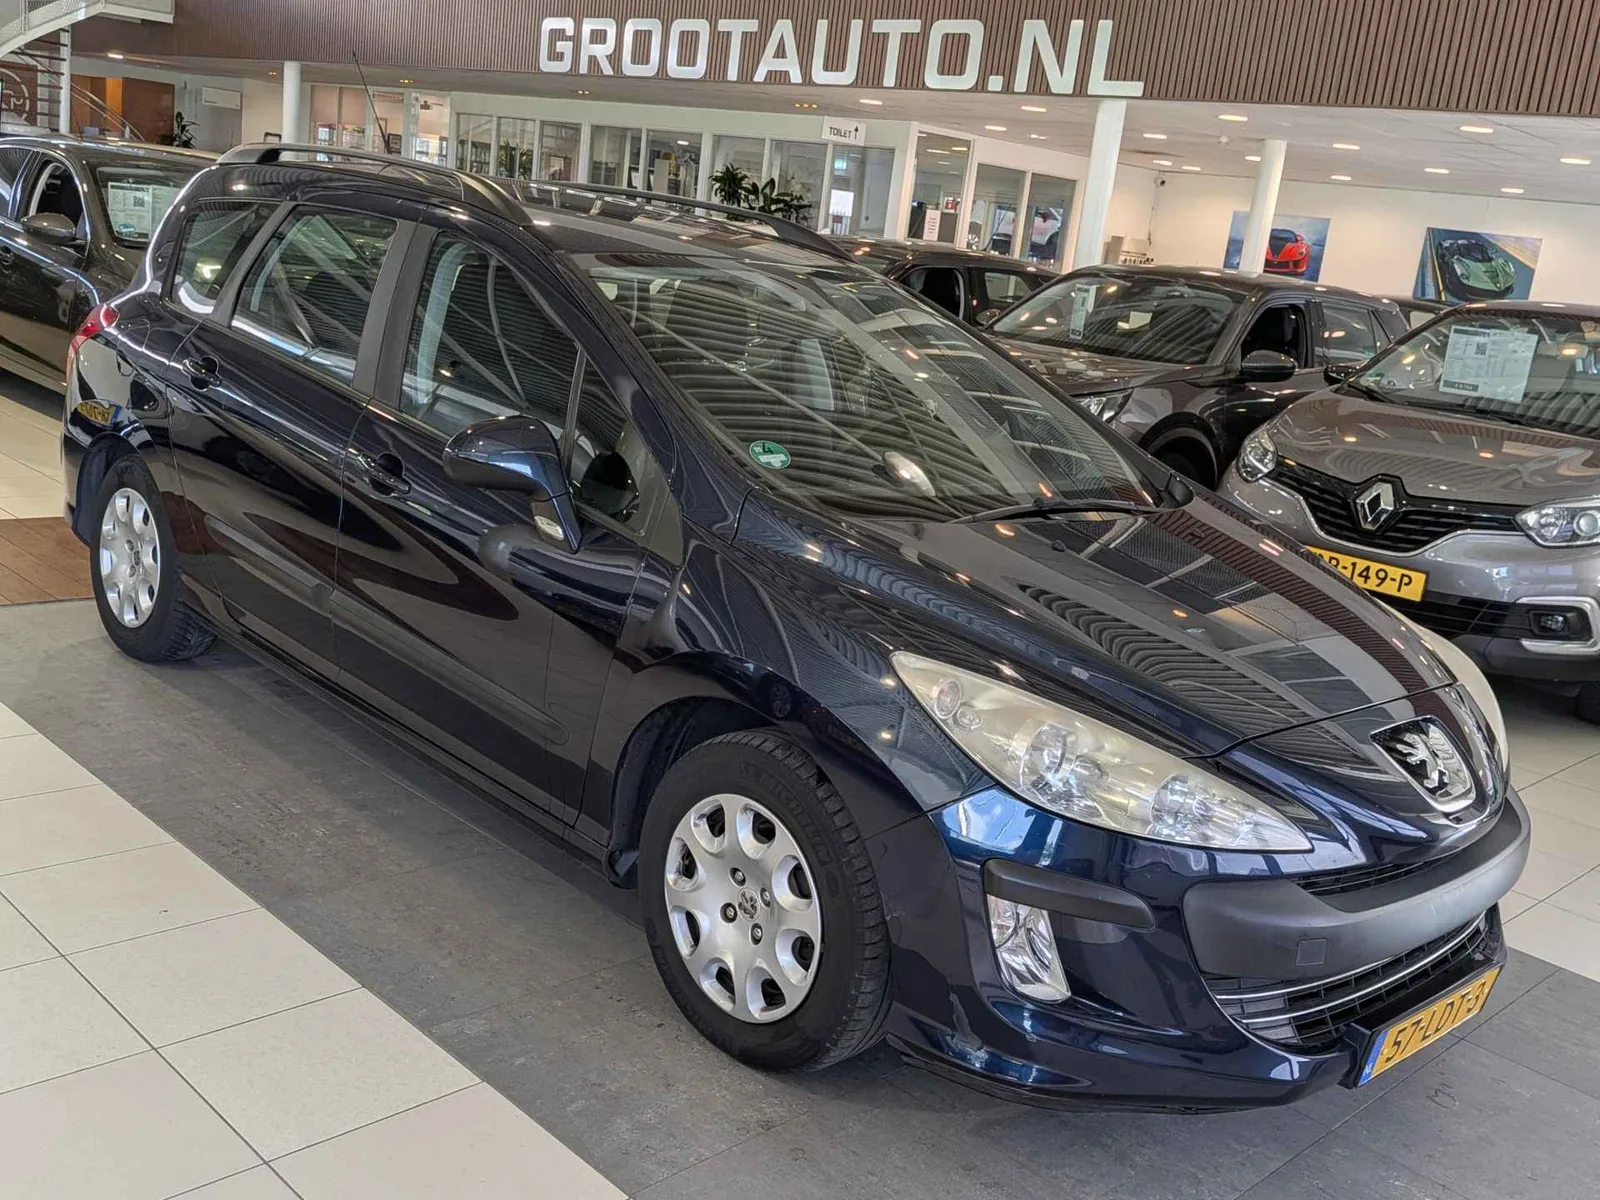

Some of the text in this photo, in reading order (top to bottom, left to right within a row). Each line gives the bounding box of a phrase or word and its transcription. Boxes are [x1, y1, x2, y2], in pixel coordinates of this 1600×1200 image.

[539, 17, 1144, 97] GROOTAUTO.NL
[829, 127, 853, 139] TOILET
[1384, 979, 1487, 1064] 57-LDT-3
